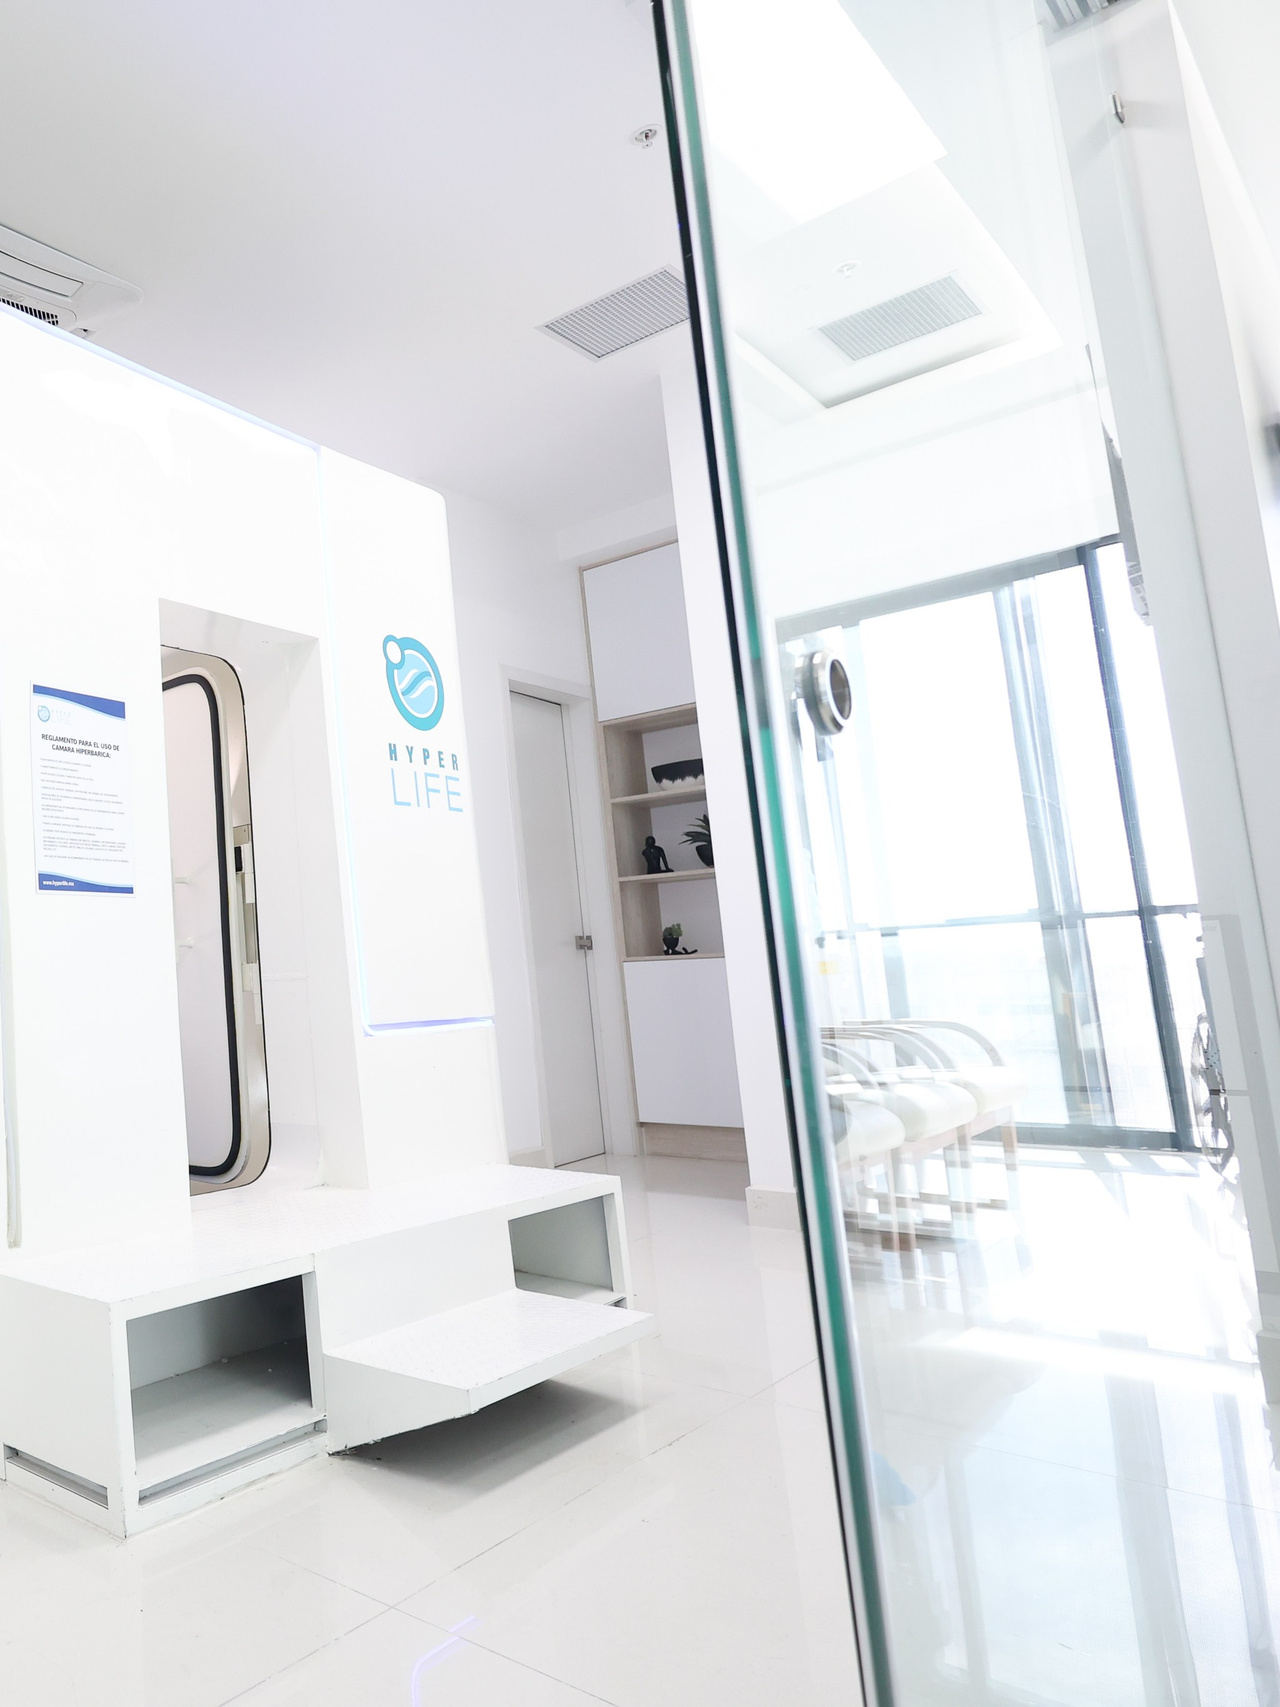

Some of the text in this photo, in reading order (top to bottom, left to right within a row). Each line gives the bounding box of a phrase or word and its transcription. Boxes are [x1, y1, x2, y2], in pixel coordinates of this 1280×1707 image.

[41, 733, 78, 745] REGLAMENTO
[78, 739, 93, 747] PARA
[93, 741, 100, 749] EL
[112, 744, 120, 752] DE
[51, 743, 112, 759] CAMARA HIPERBARICA:
[388, 742, 459, 771] HYPER
[390, 767, 464, 813] LIFE
